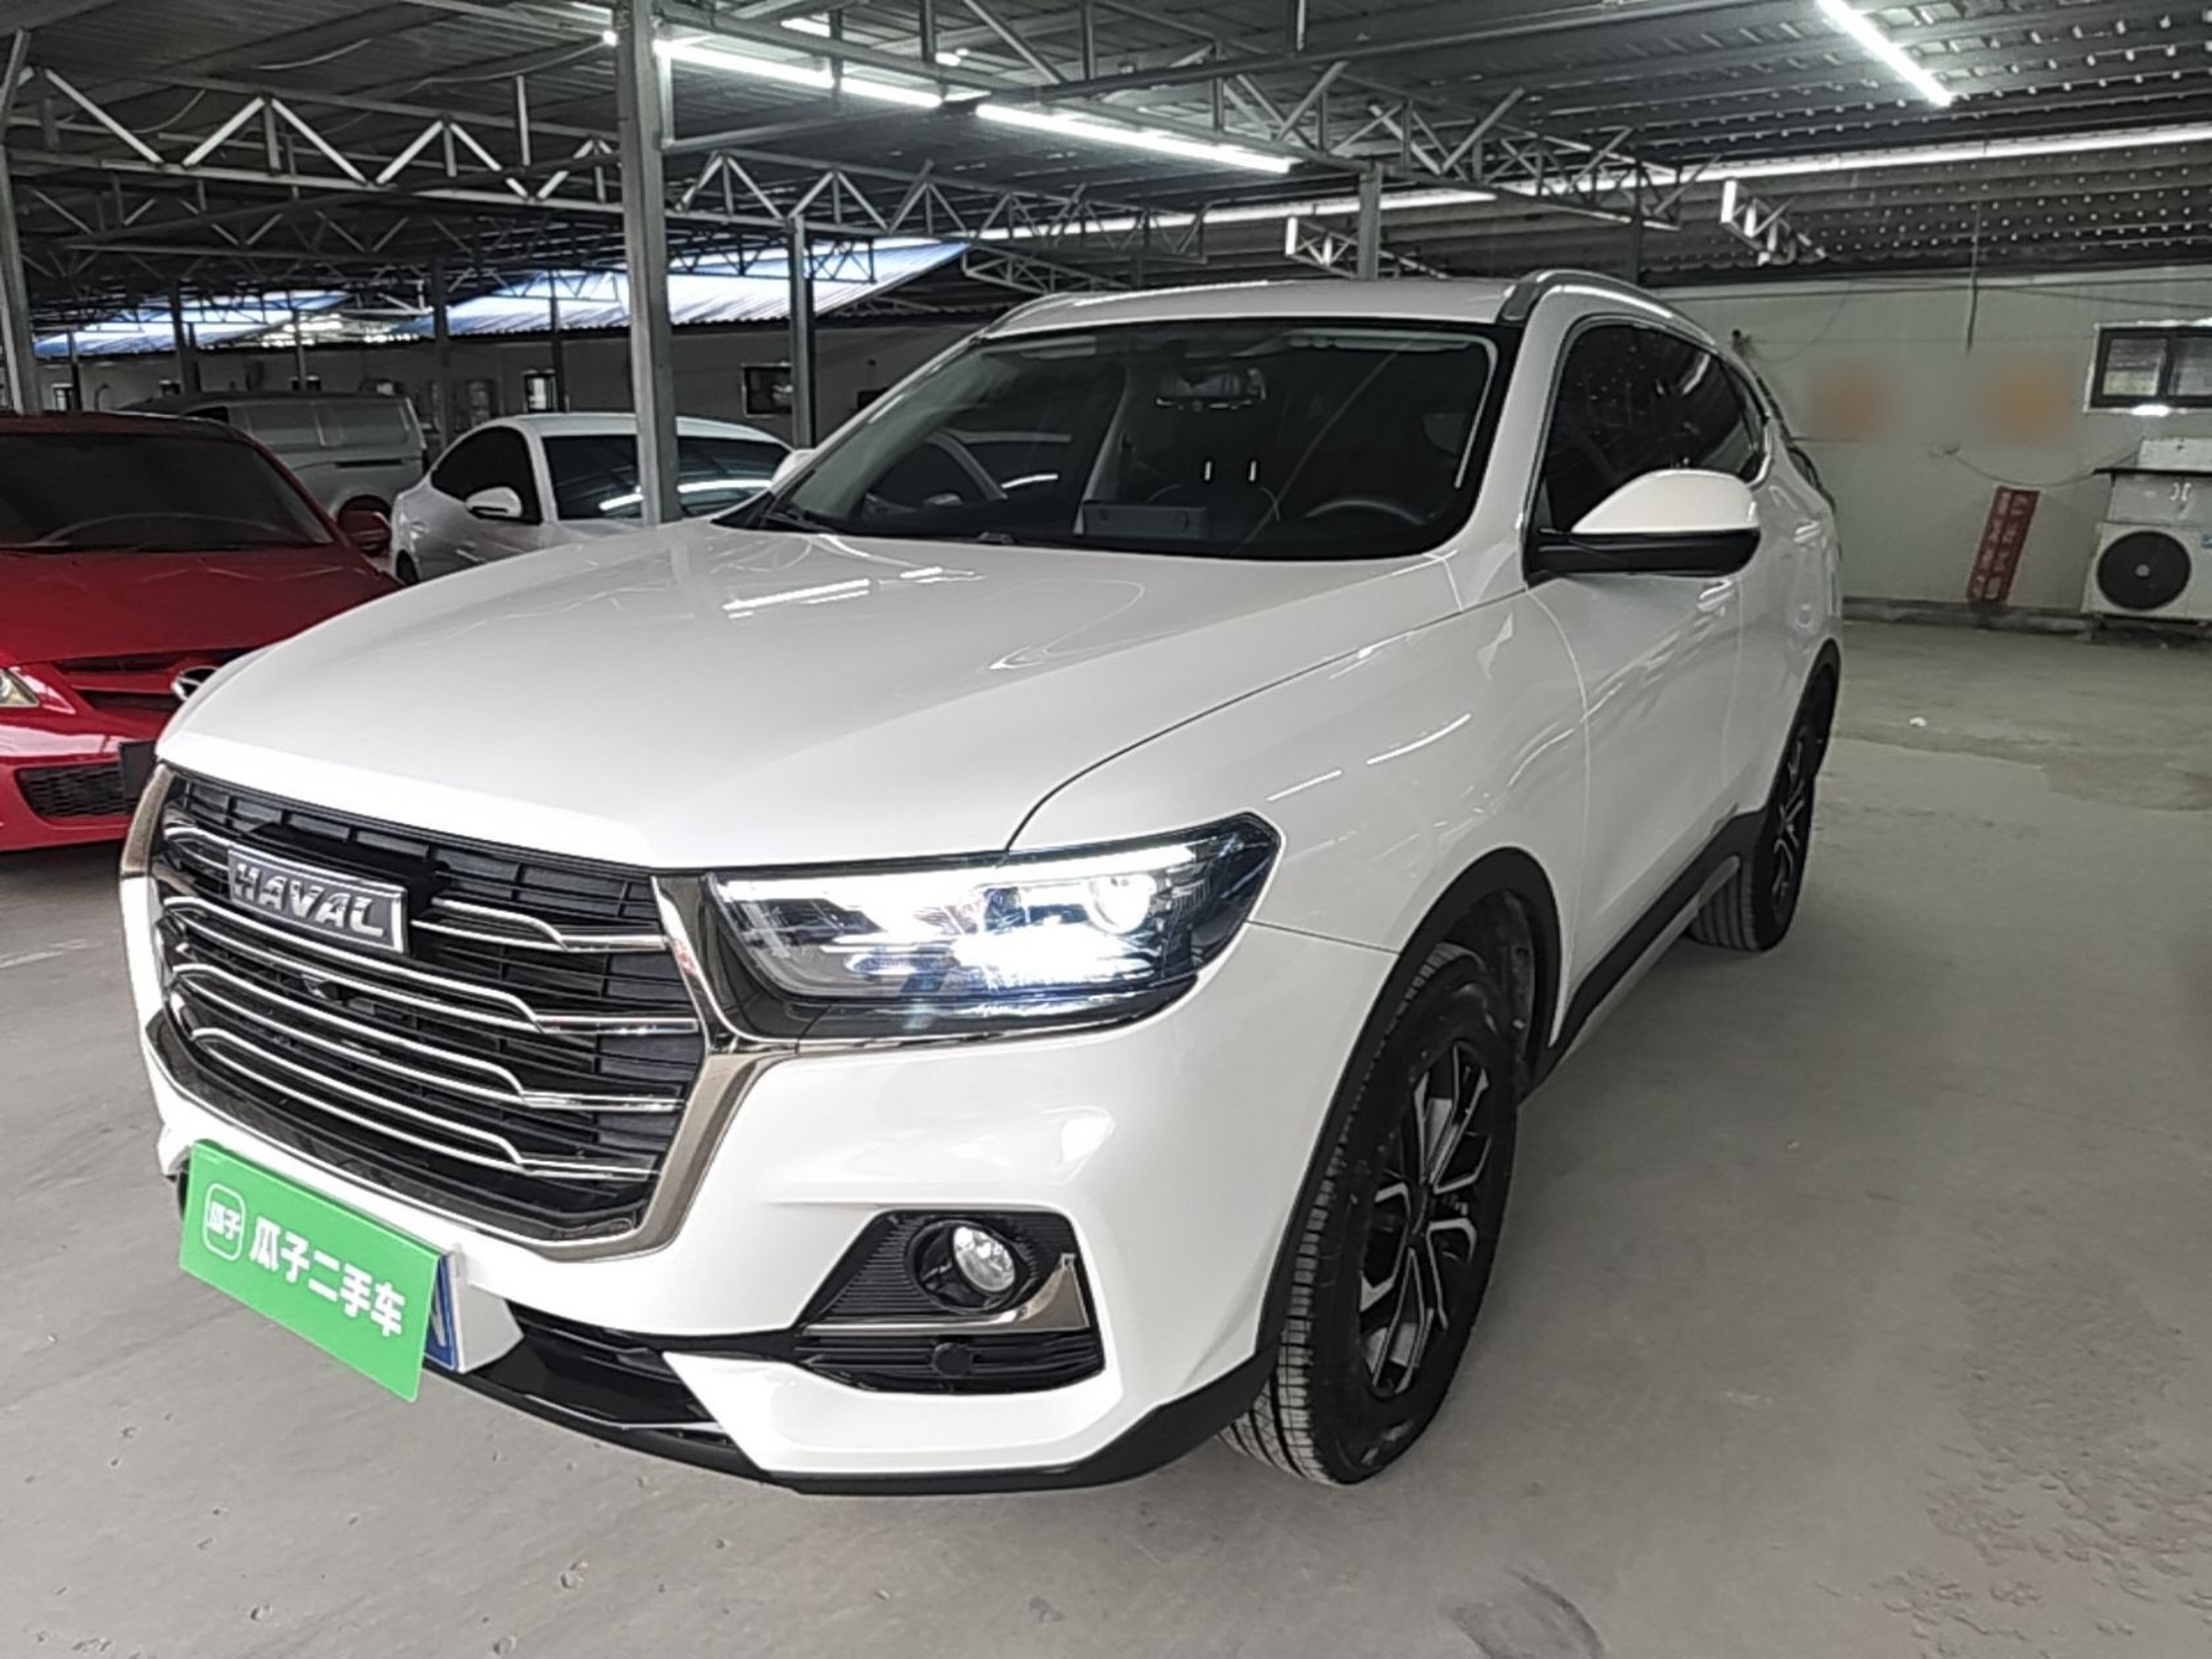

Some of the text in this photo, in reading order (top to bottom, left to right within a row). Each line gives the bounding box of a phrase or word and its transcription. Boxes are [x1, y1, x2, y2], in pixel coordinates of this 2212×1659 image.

[233, 863, 384, 937] HAVAL
[249, 1215, 406, 1336] 瓜子二手车
